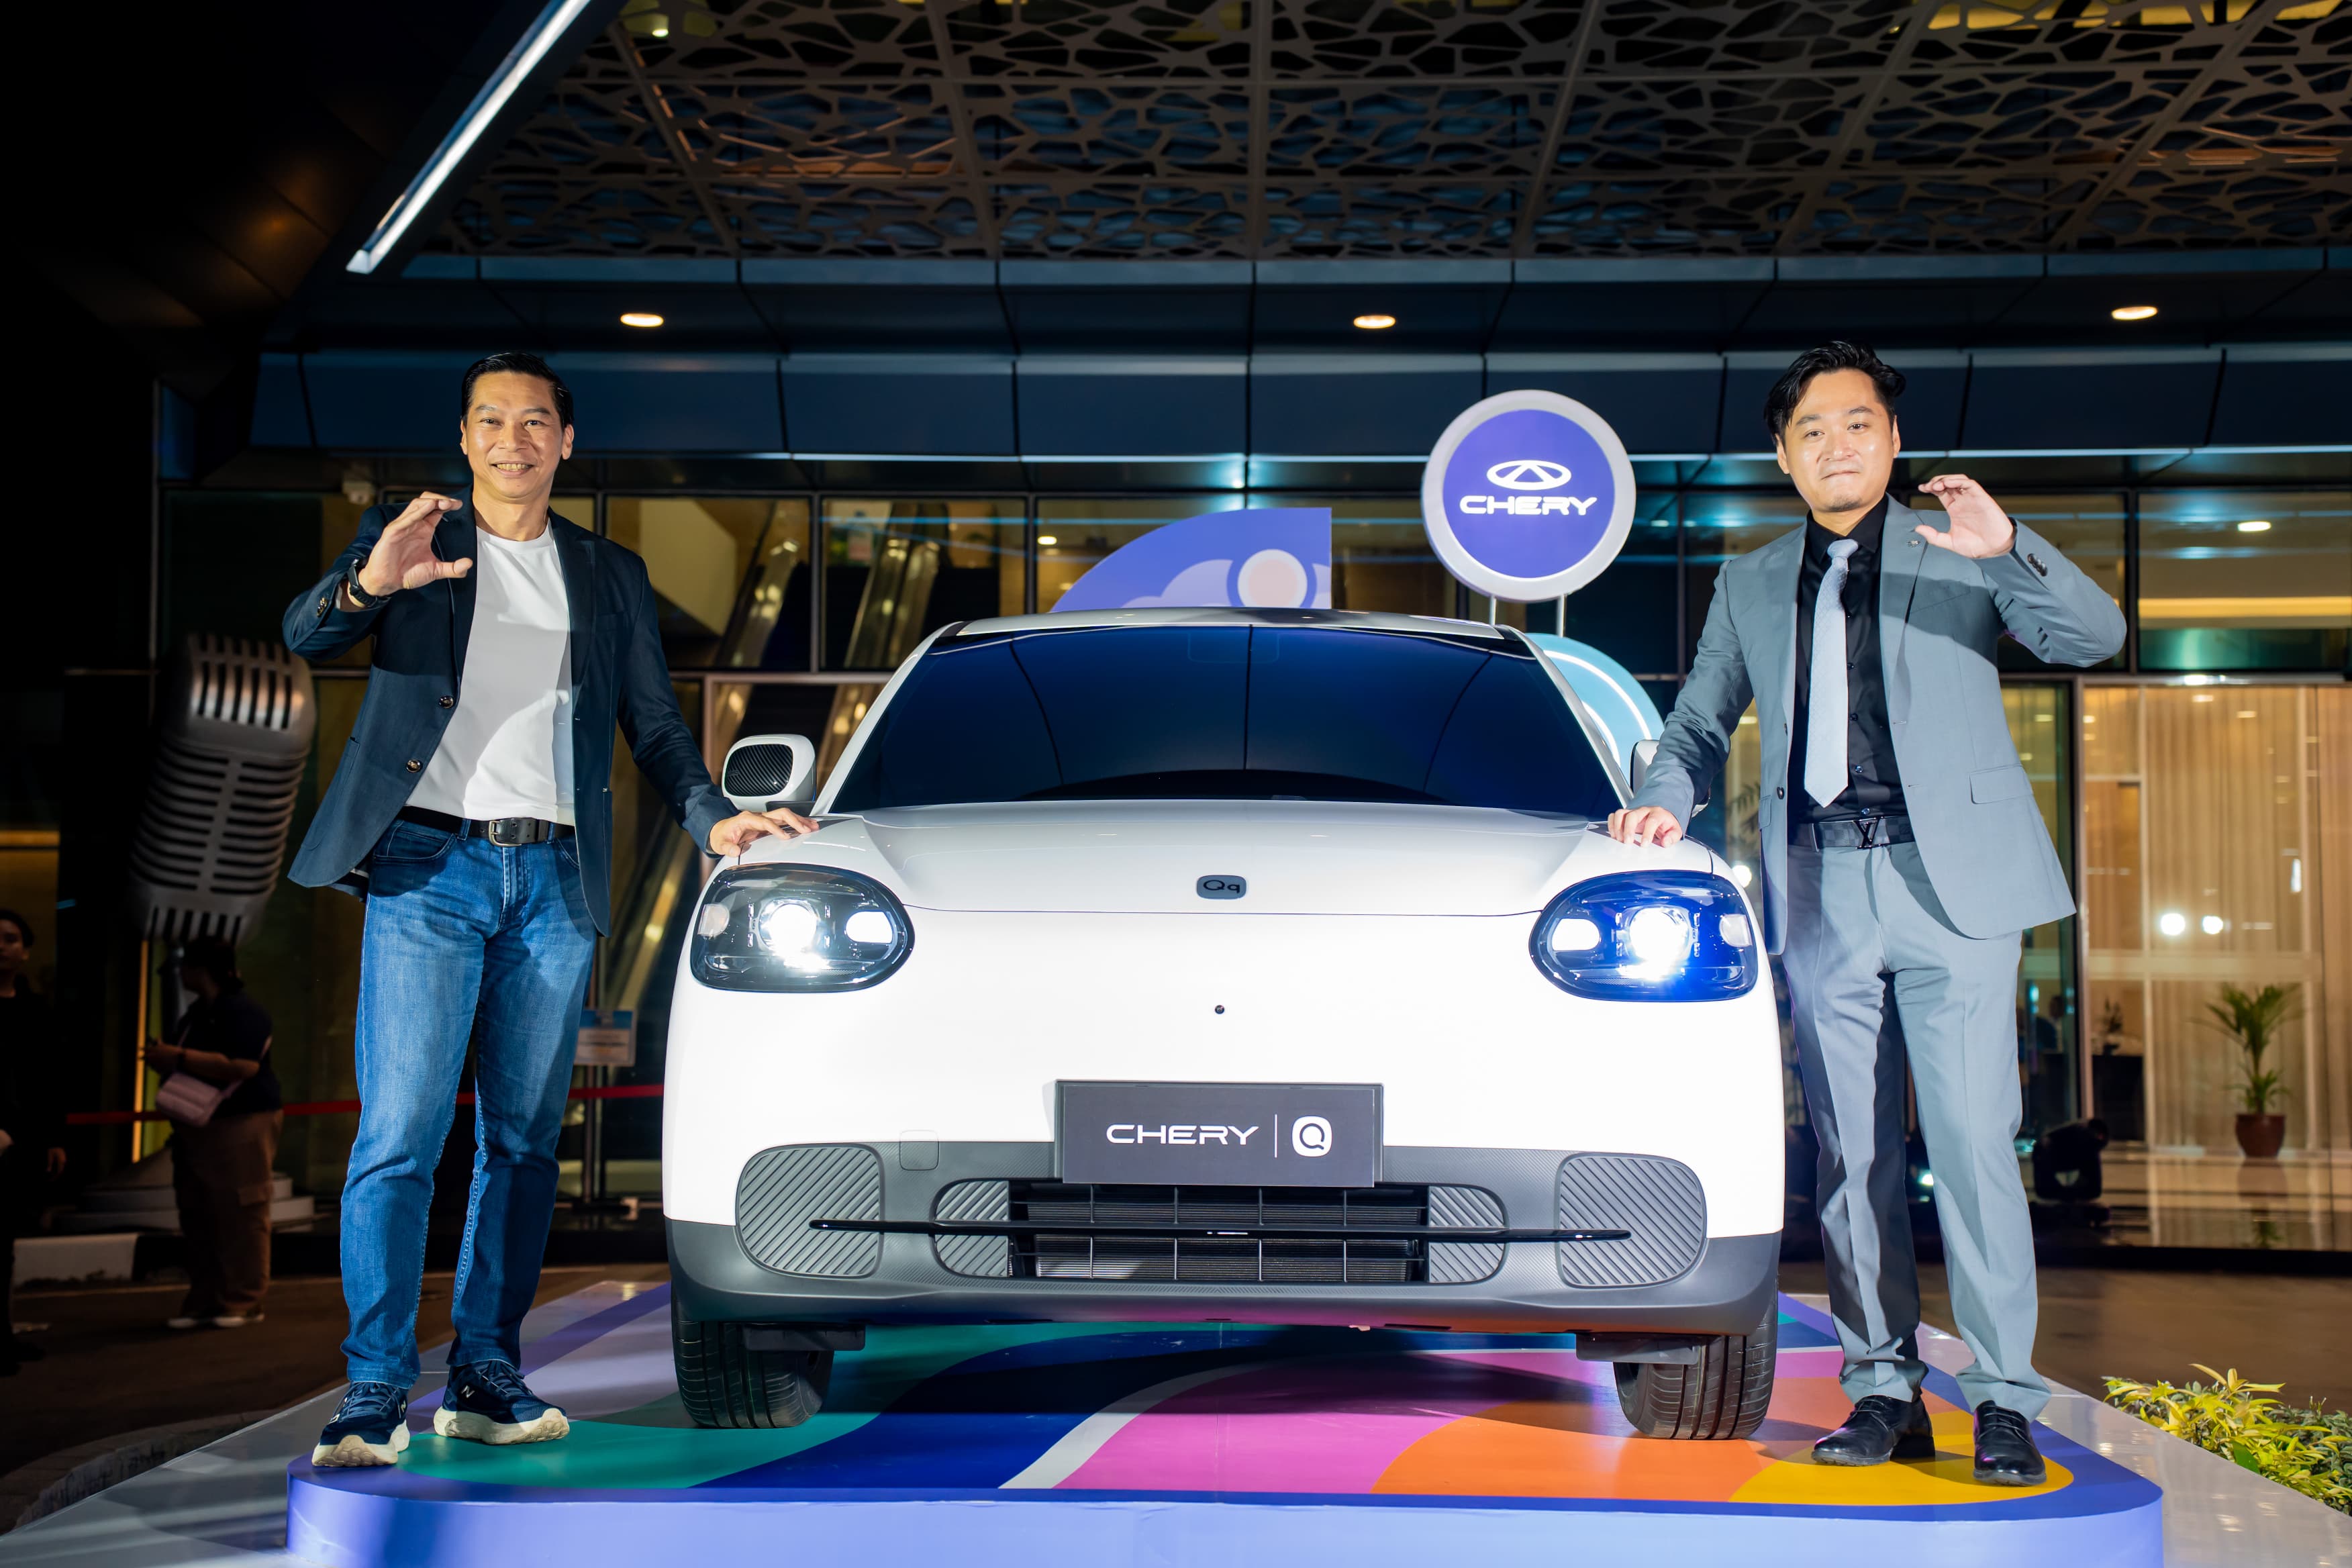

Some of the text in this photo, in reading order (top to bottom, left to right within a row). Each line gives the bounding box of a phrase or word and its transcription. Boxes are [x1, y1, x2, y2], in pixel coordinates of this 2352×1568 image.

[1459, 495, 1598, 516] CHERY
[1106, 1122, 1325, 1150] CHERY Q
